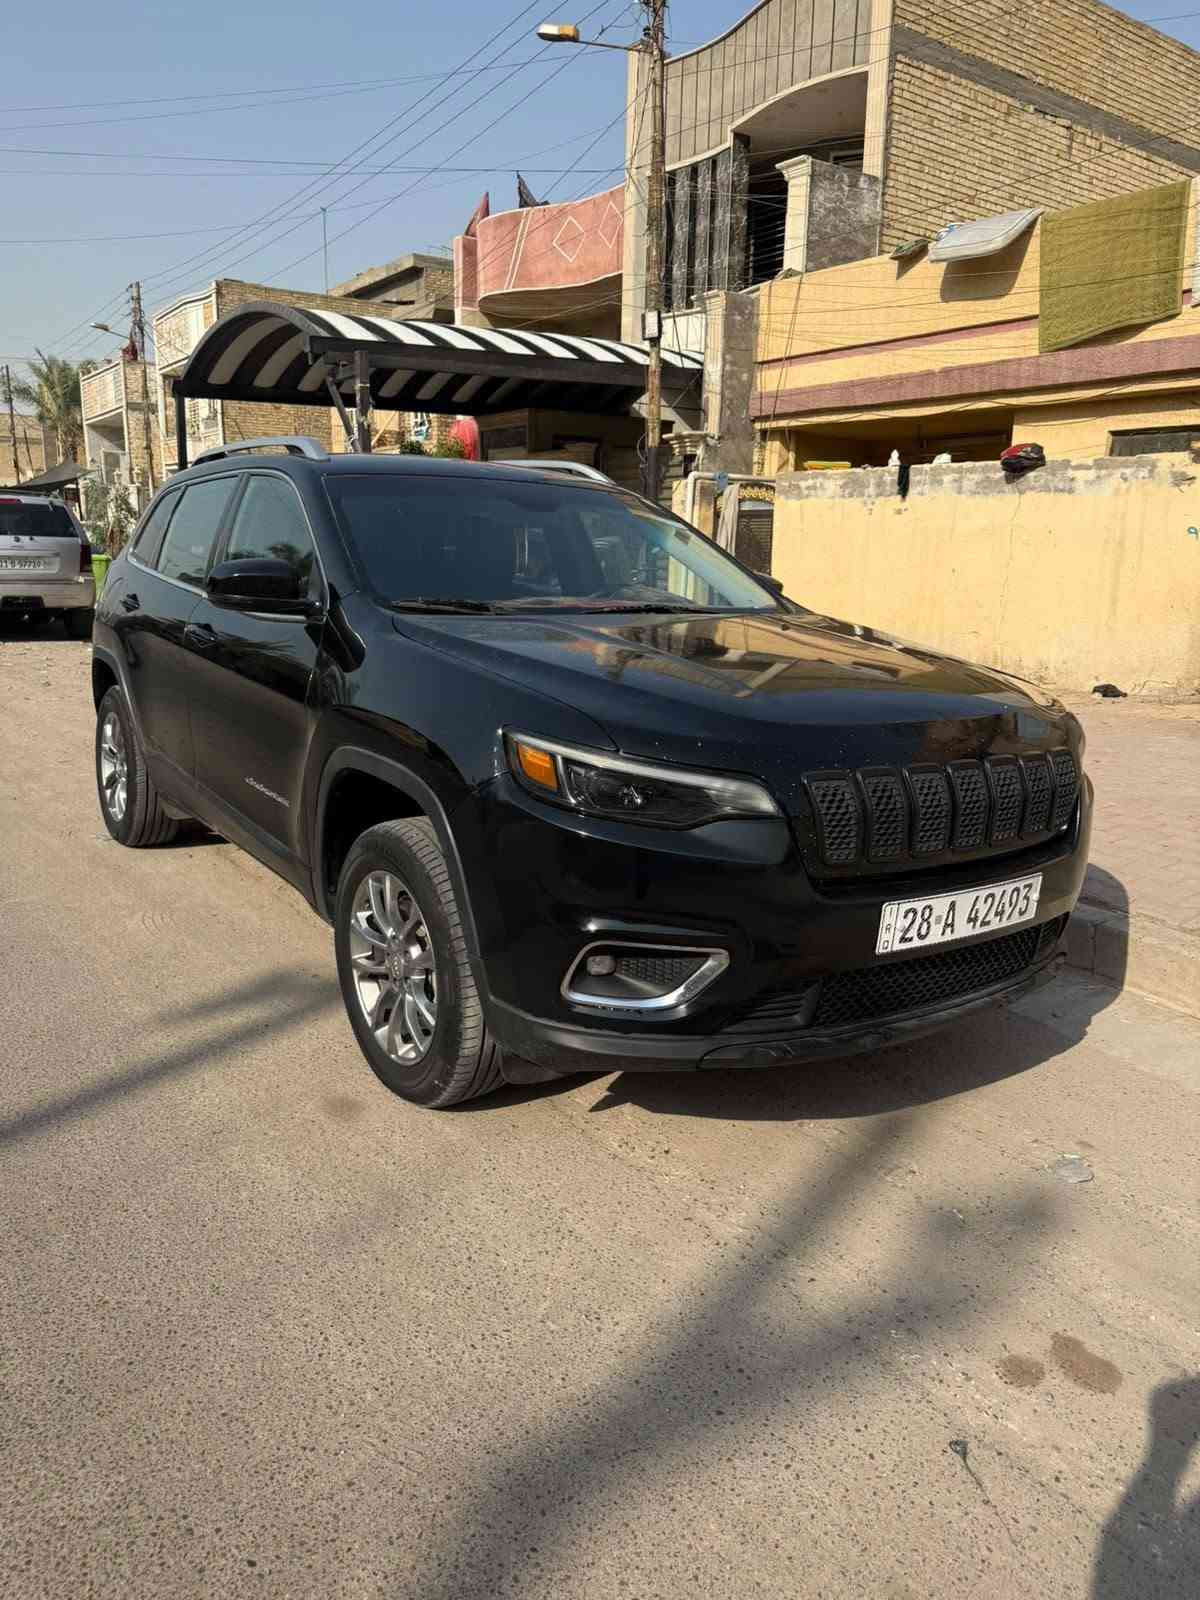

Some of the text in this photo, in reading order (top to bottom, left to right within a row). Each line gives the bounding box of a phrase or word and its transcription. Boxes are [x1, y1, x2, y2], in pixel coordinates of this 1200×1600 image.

[899, 883, 1033, 943] 28 A 42493
